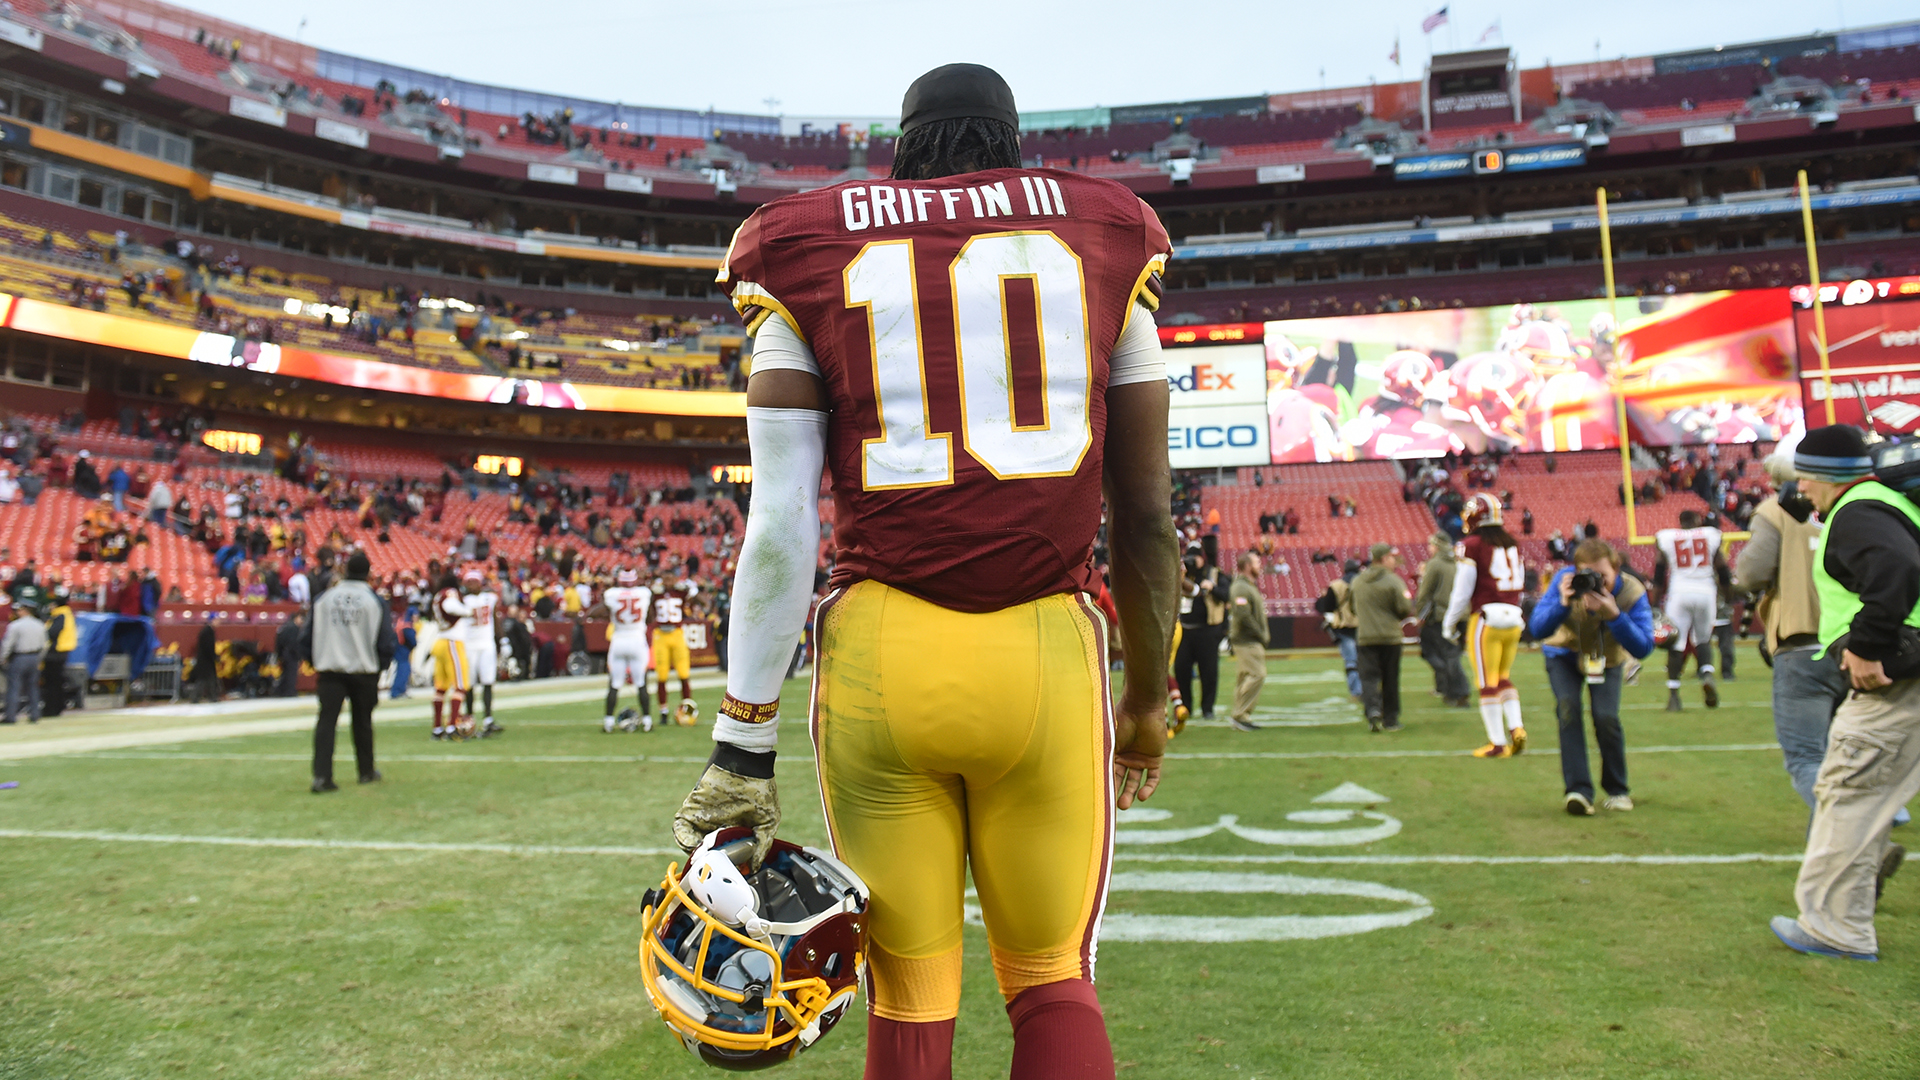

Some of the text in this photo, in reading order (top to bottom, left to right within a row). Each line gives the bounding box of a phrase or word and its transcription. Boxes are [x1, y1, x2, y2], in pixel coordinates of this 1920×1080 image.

[841, 176, 1067, 231] GRIFFIN III
[1174, 330, 1197, 343] AND
[842, 230, 1093, 492] 10
[1167, 363, 1236, 393] edEx
[1168, 425, 1258, 449] EICO
[1674, 538, 1709, 568] 69
[1489, 546, 1525, 591] 41
[616, 598, 642, 624] 25
[655, 597, 684, 623] 35
